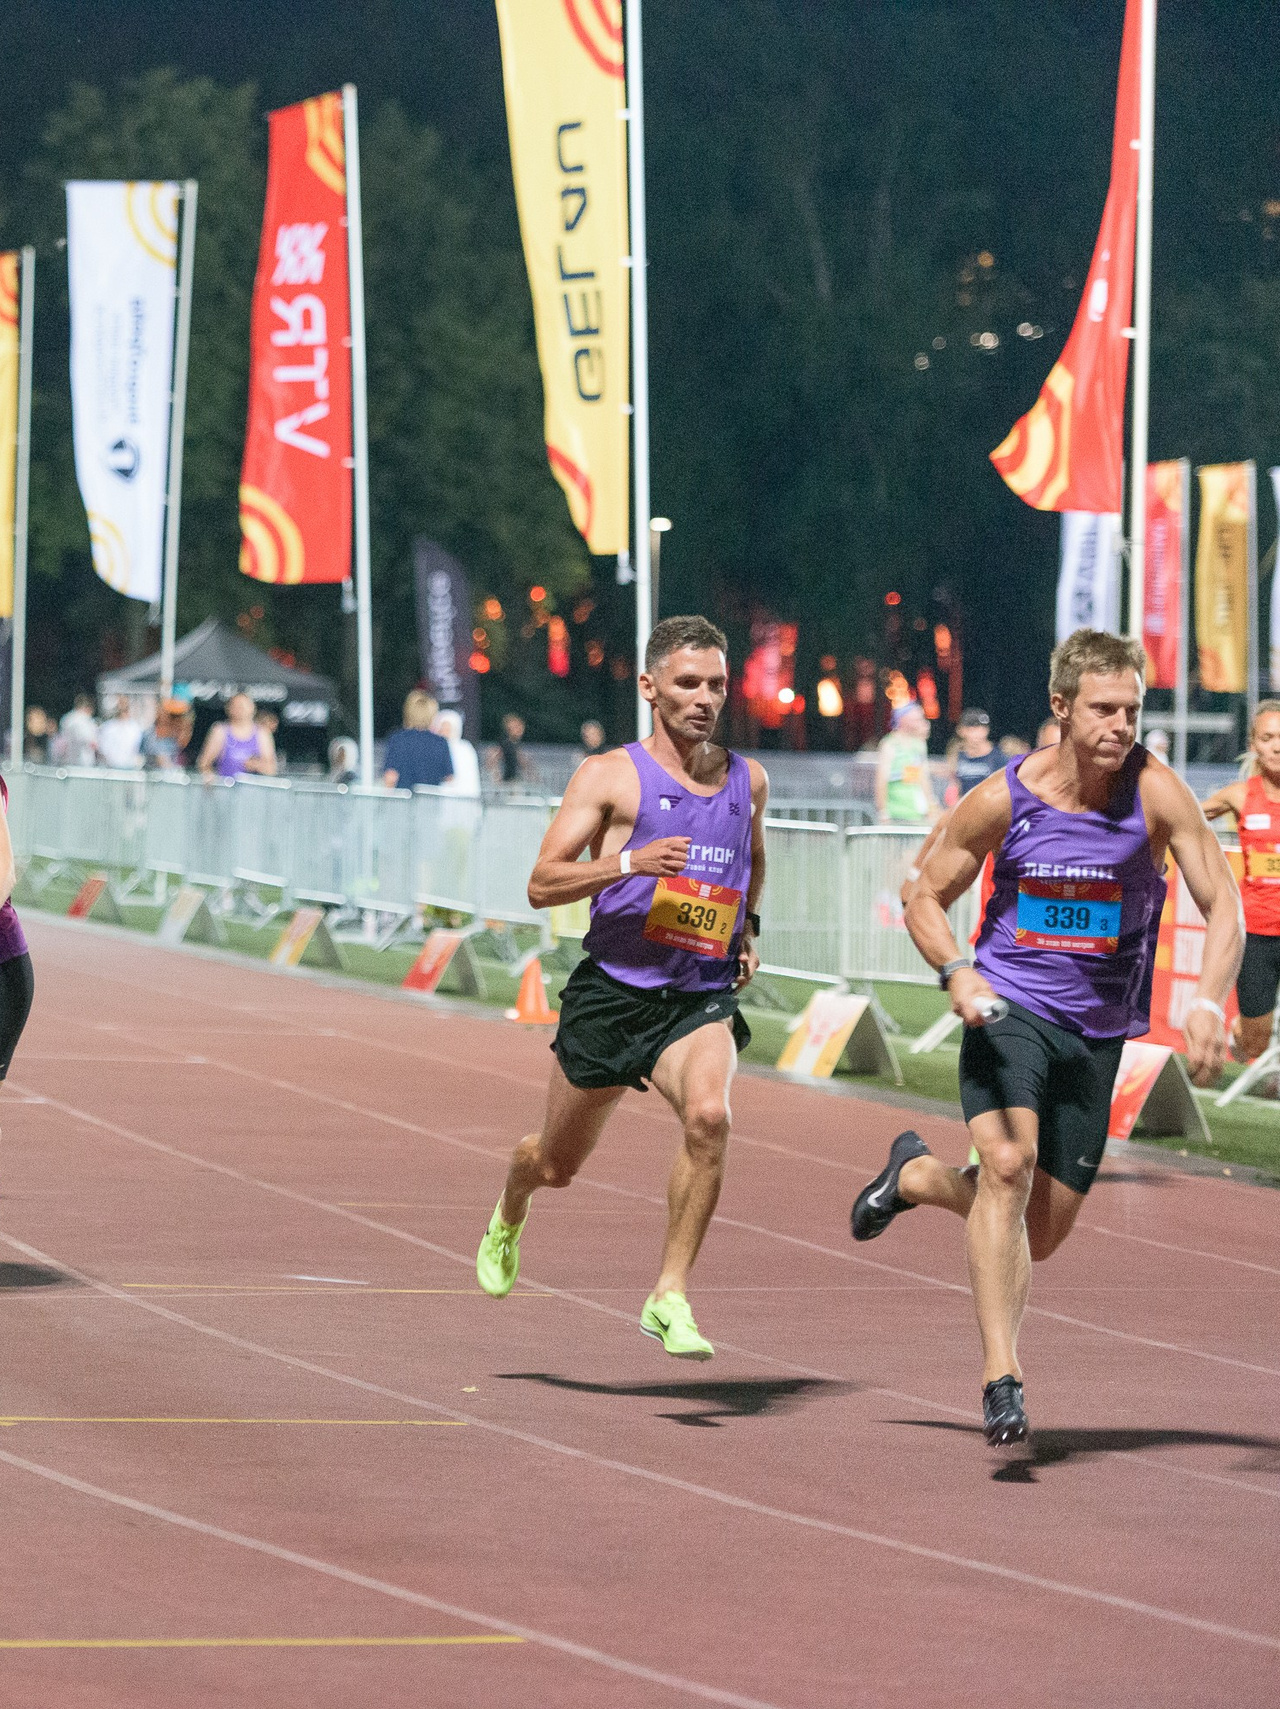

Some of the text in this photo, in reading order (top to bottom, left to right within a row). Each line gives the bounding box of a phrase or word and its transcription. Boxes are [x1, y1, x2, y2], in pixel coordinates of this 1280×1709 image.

[687, 844, 736, 865] ГИОН
[677, 902, 727, 935] 339 2
[1043, 905, 1108, 931] 339 3
